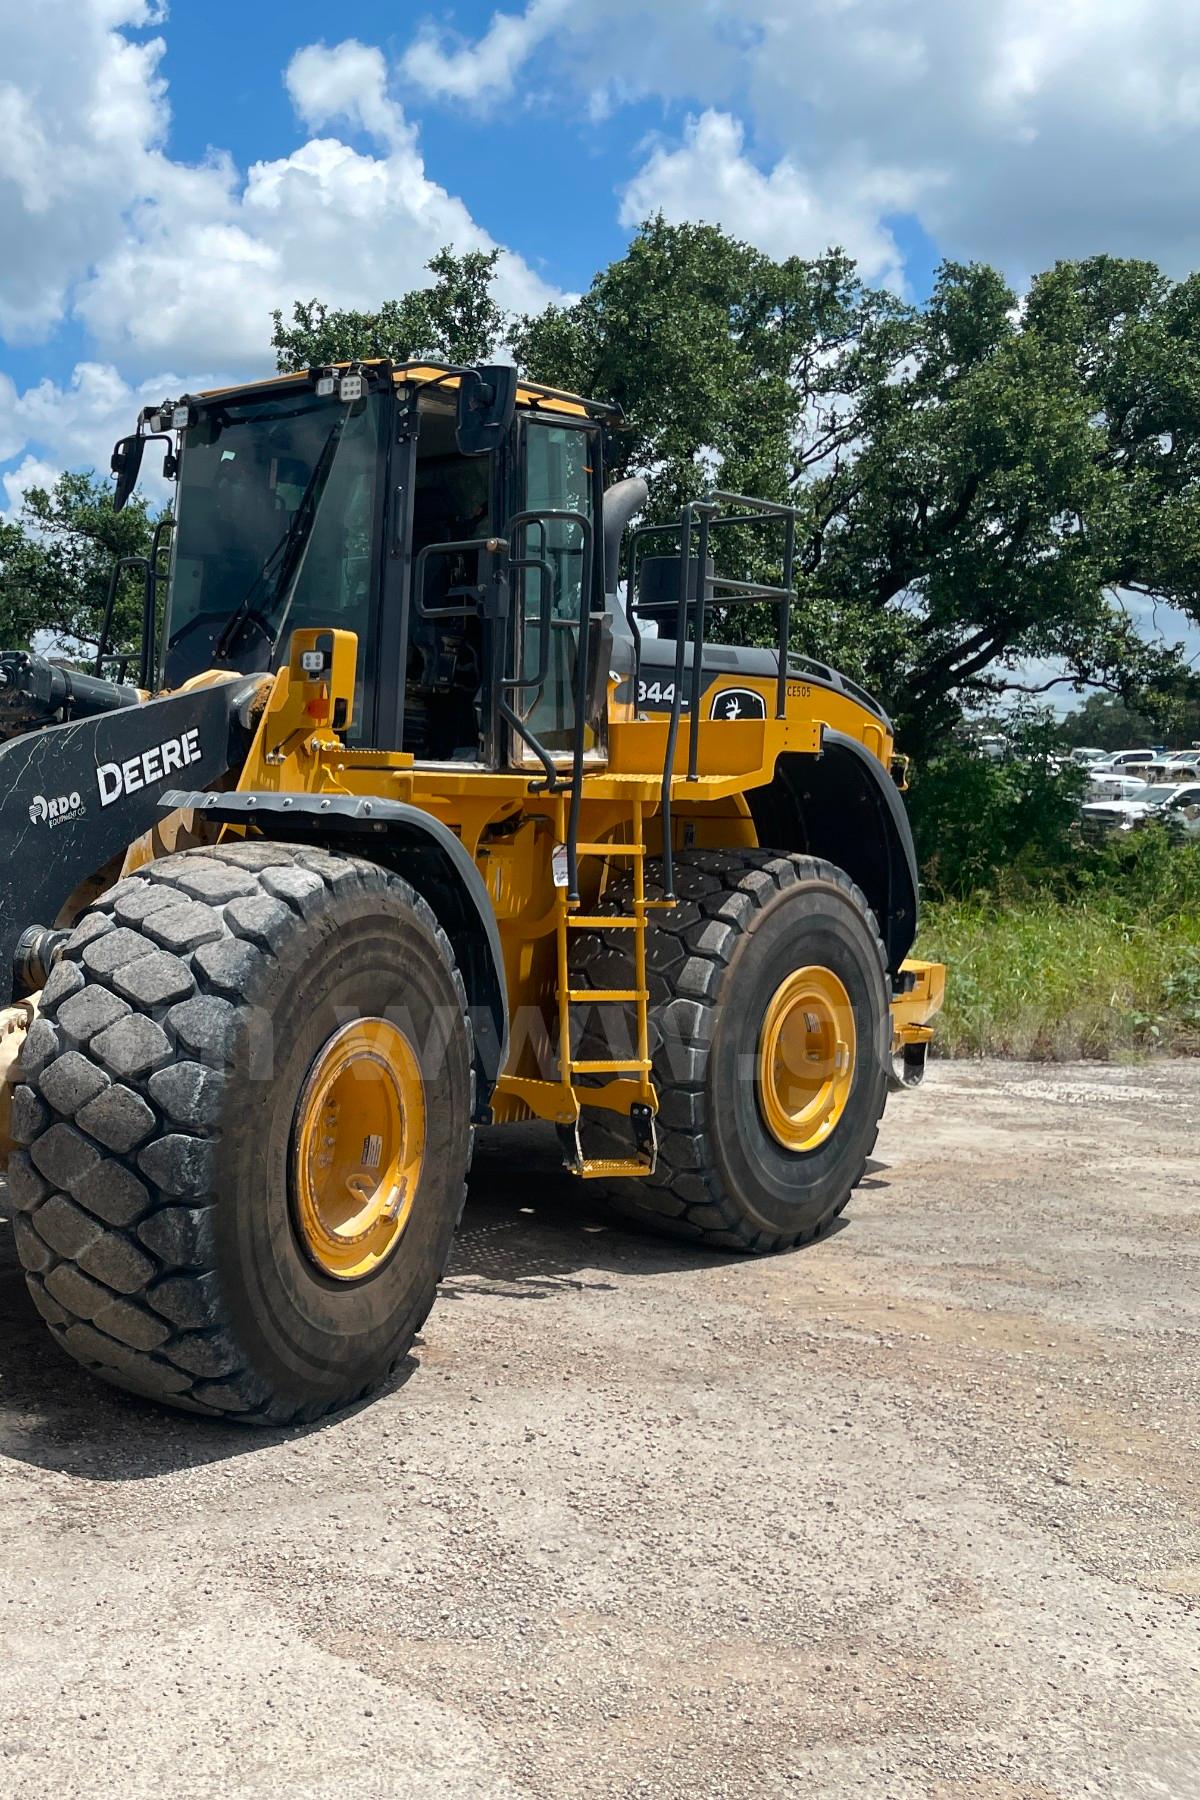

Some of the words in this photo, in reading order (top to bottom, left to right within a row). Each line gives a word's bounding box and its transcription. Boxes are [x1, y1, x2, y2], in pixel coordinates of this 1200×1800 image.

[787, 686, 811, 698] CE505
[96, 728, 202, 807] DEERE
[48, 791, 81, 819] RDO
